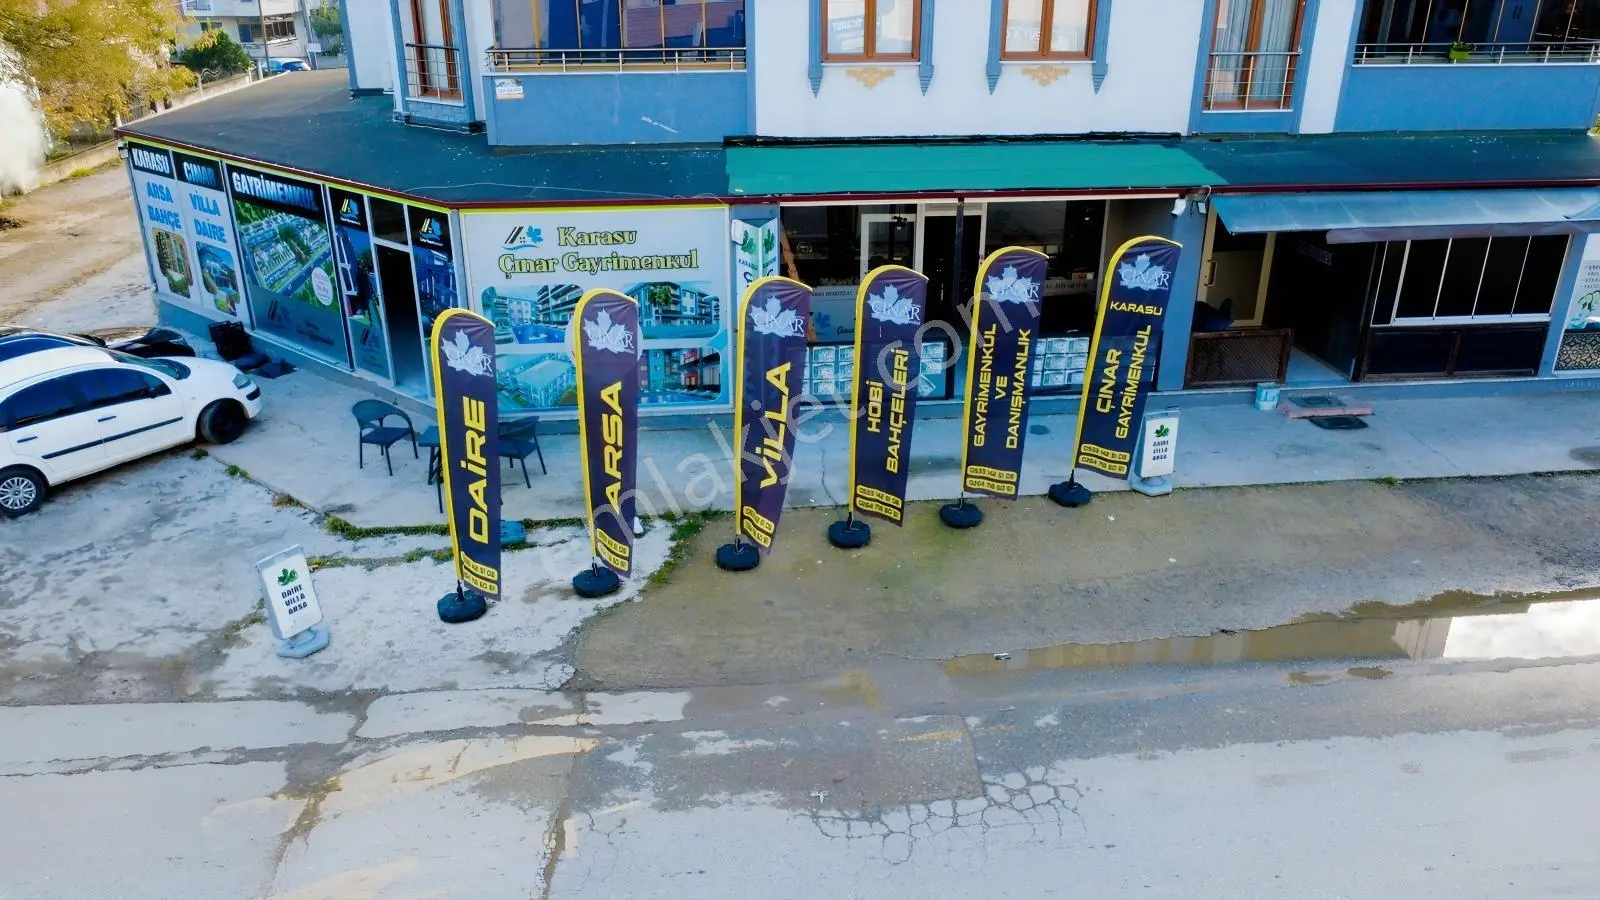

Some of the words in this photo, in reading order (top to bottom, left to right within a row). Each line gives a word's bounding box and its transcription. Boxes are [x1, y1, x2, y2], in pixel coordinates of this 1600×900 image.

[131, 148, 171, 175] KARASU
[146, 181, 173, 204] ARSA
[189, 190, 221, 217] VİLLA
[147, 205, 182, 231] BAHÇE
[194, 215, 228, 244] DAİRE
[557, 226, 637, 247] Karasu
[498, 253, 559, 279] Çınar
[562, 248, 699, 275] Gayrimenkul
[1109, 301, 1163, 316] KARASU
[973, 323, 997, 447] GAYRİMENKUL
[994, 375, 1008, 400] VE
[1006, 328, 1032, 449] DANIŞMANLIK
[1096, 348, 1122, 413] ÇINAR
[1115, 324, 1151, 439] GAYRİMENKUL
[755, 361, 792, 489] VİLLA
[865, 380, 884, 433] HOBİ
[886, 348, 909, 474] BAHÇELERİ
[600, 381, 624, 516] ARSA
[460, 396, 489, 545] DAİRE
